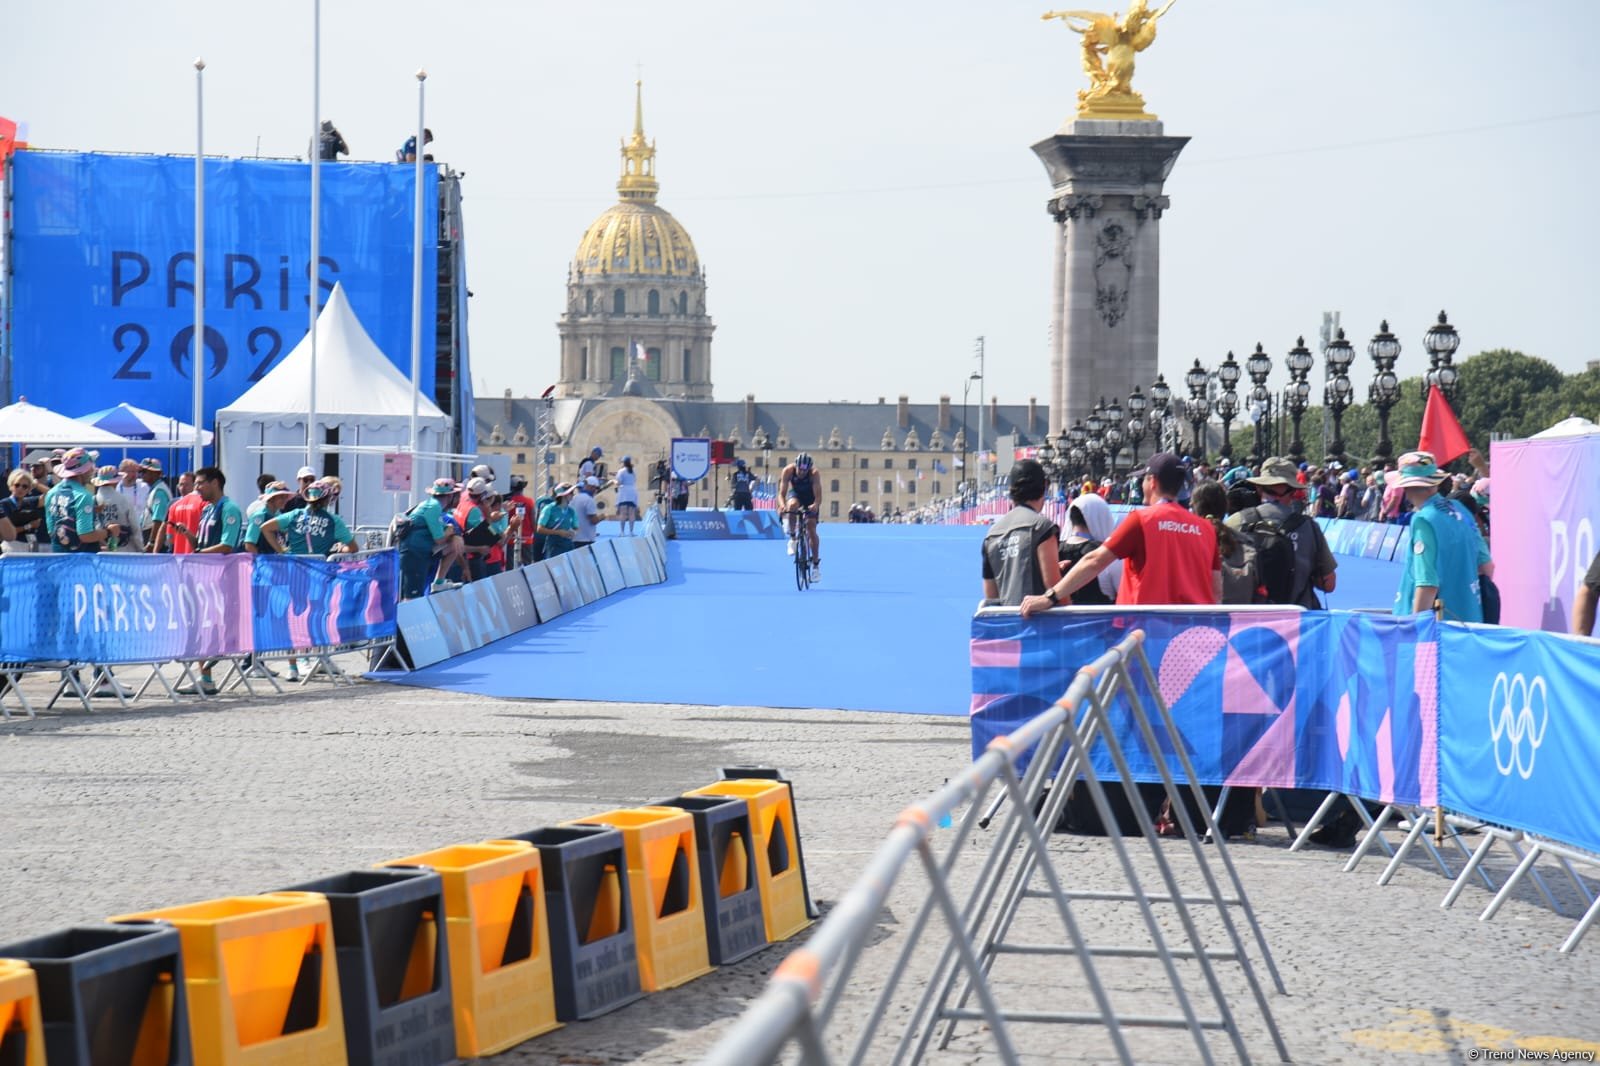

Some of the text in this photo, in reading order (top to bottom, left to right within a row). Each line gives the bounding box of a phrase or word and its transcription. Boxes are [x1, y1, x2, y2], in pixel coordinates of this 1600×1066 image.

[112, 323, 311, 382] 202
[1158, 520, 1202, 535] MEDICAL
[161, 582, 226, 629] 2024
